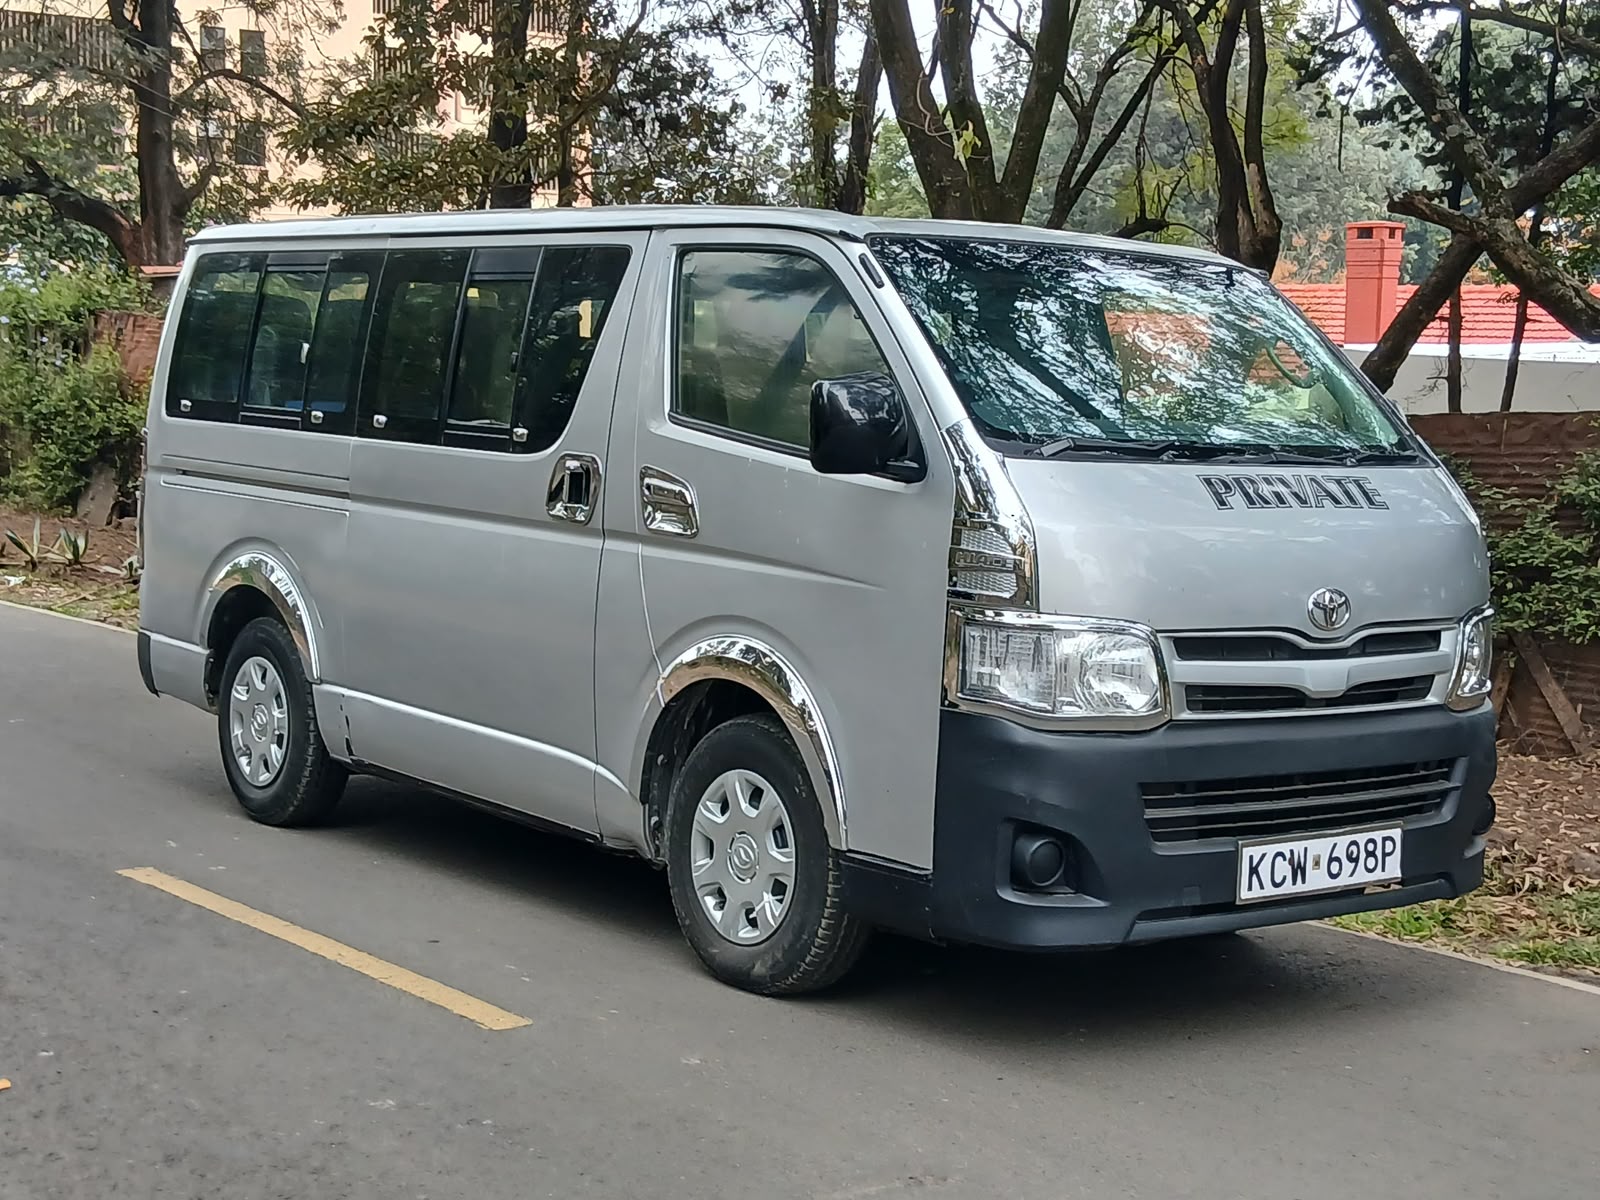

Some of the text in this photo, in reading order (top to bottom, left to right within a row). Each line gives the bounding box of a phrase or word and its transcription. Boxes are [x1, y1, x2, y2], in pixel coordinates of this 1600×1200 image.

[1196, 474, 1390, 510] PRIVATE
[1247, 835, 1397, 892] KCW 698P
